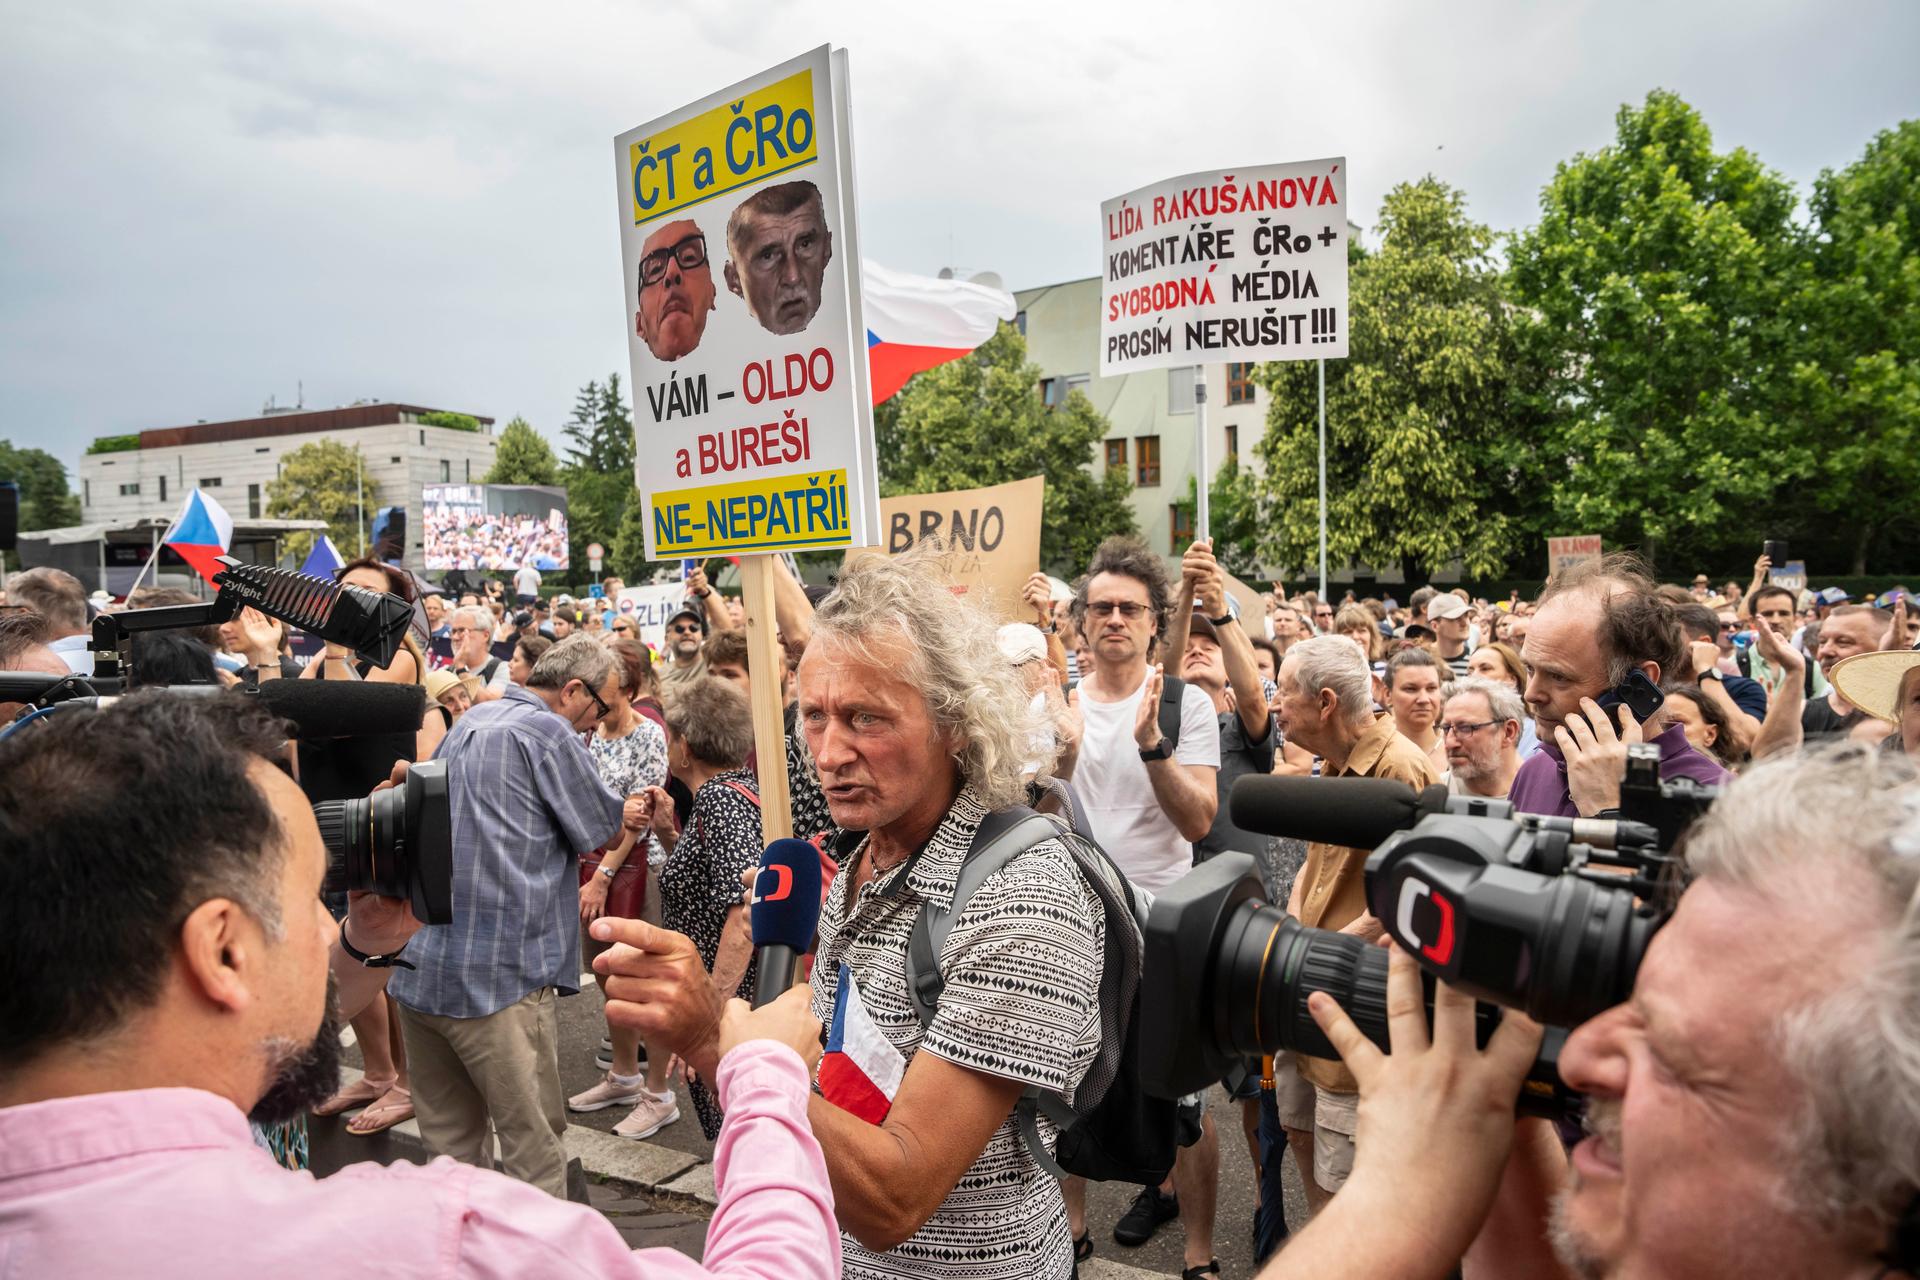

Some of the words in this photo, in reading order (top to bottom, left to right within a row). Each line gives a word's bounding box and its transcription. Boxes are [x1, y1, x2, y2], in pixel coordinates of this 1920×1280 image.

[634, 141, 680, 210] ČT
[693, 146, 715, 189] a
[725, 100, 813, 175] ČRo
[1109, 200, 1144, 241] LÍDA
[1153, 165, 1338, 226] RAKUŠANOVÁ
[1110, 222, 1235, 282] KOMENTÁŘE
[1109, 264, 1218, 322] SVOBODNÁ
[1232, 260, 1320, 303] MÉDIA
[1108, 317, 1172, 364] PROSÍM
[1185, 307, 1337, 351] NERUŠIT!!!
[647, 370, 709, 423] VÁM
[742, 347, 834, 405] OLDO
[676, 448, 692, 479] a
[698, 409, 811, 475] BUREŠI
[654, 474, 848, 546] NE-NEPATŘÍ!
[889, 506, 1004, 554] BRNO
[224, 579, 263, 601] zylight
